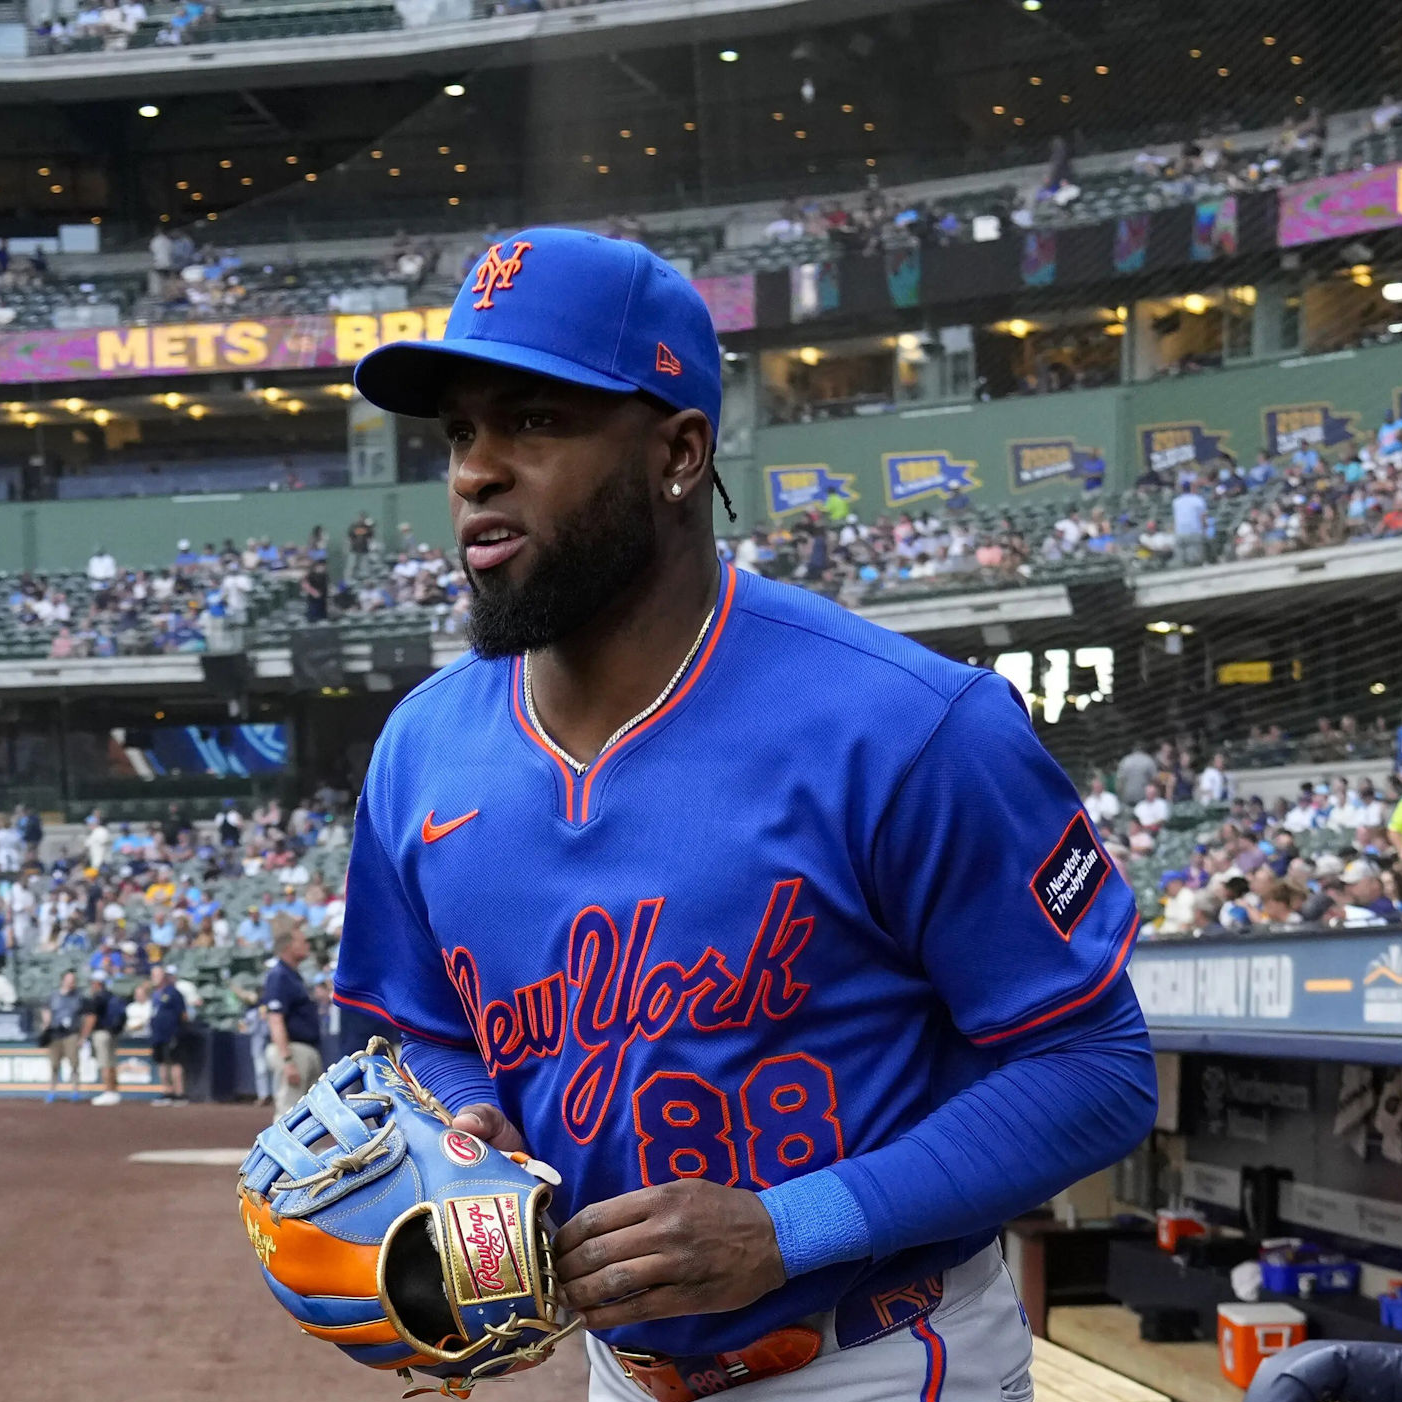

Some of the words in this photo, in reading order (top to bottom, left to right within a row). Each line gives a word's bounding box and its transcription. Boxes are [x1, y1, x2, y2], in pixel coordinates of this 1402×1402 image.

[98, 320, 268, 371] METS
[442, 946, 568, 1078] New
[562, 878, 815, 1145] York
[631, 1051, 844, 1190] 88
[466, 1203, 505, 1290] Rawlings
